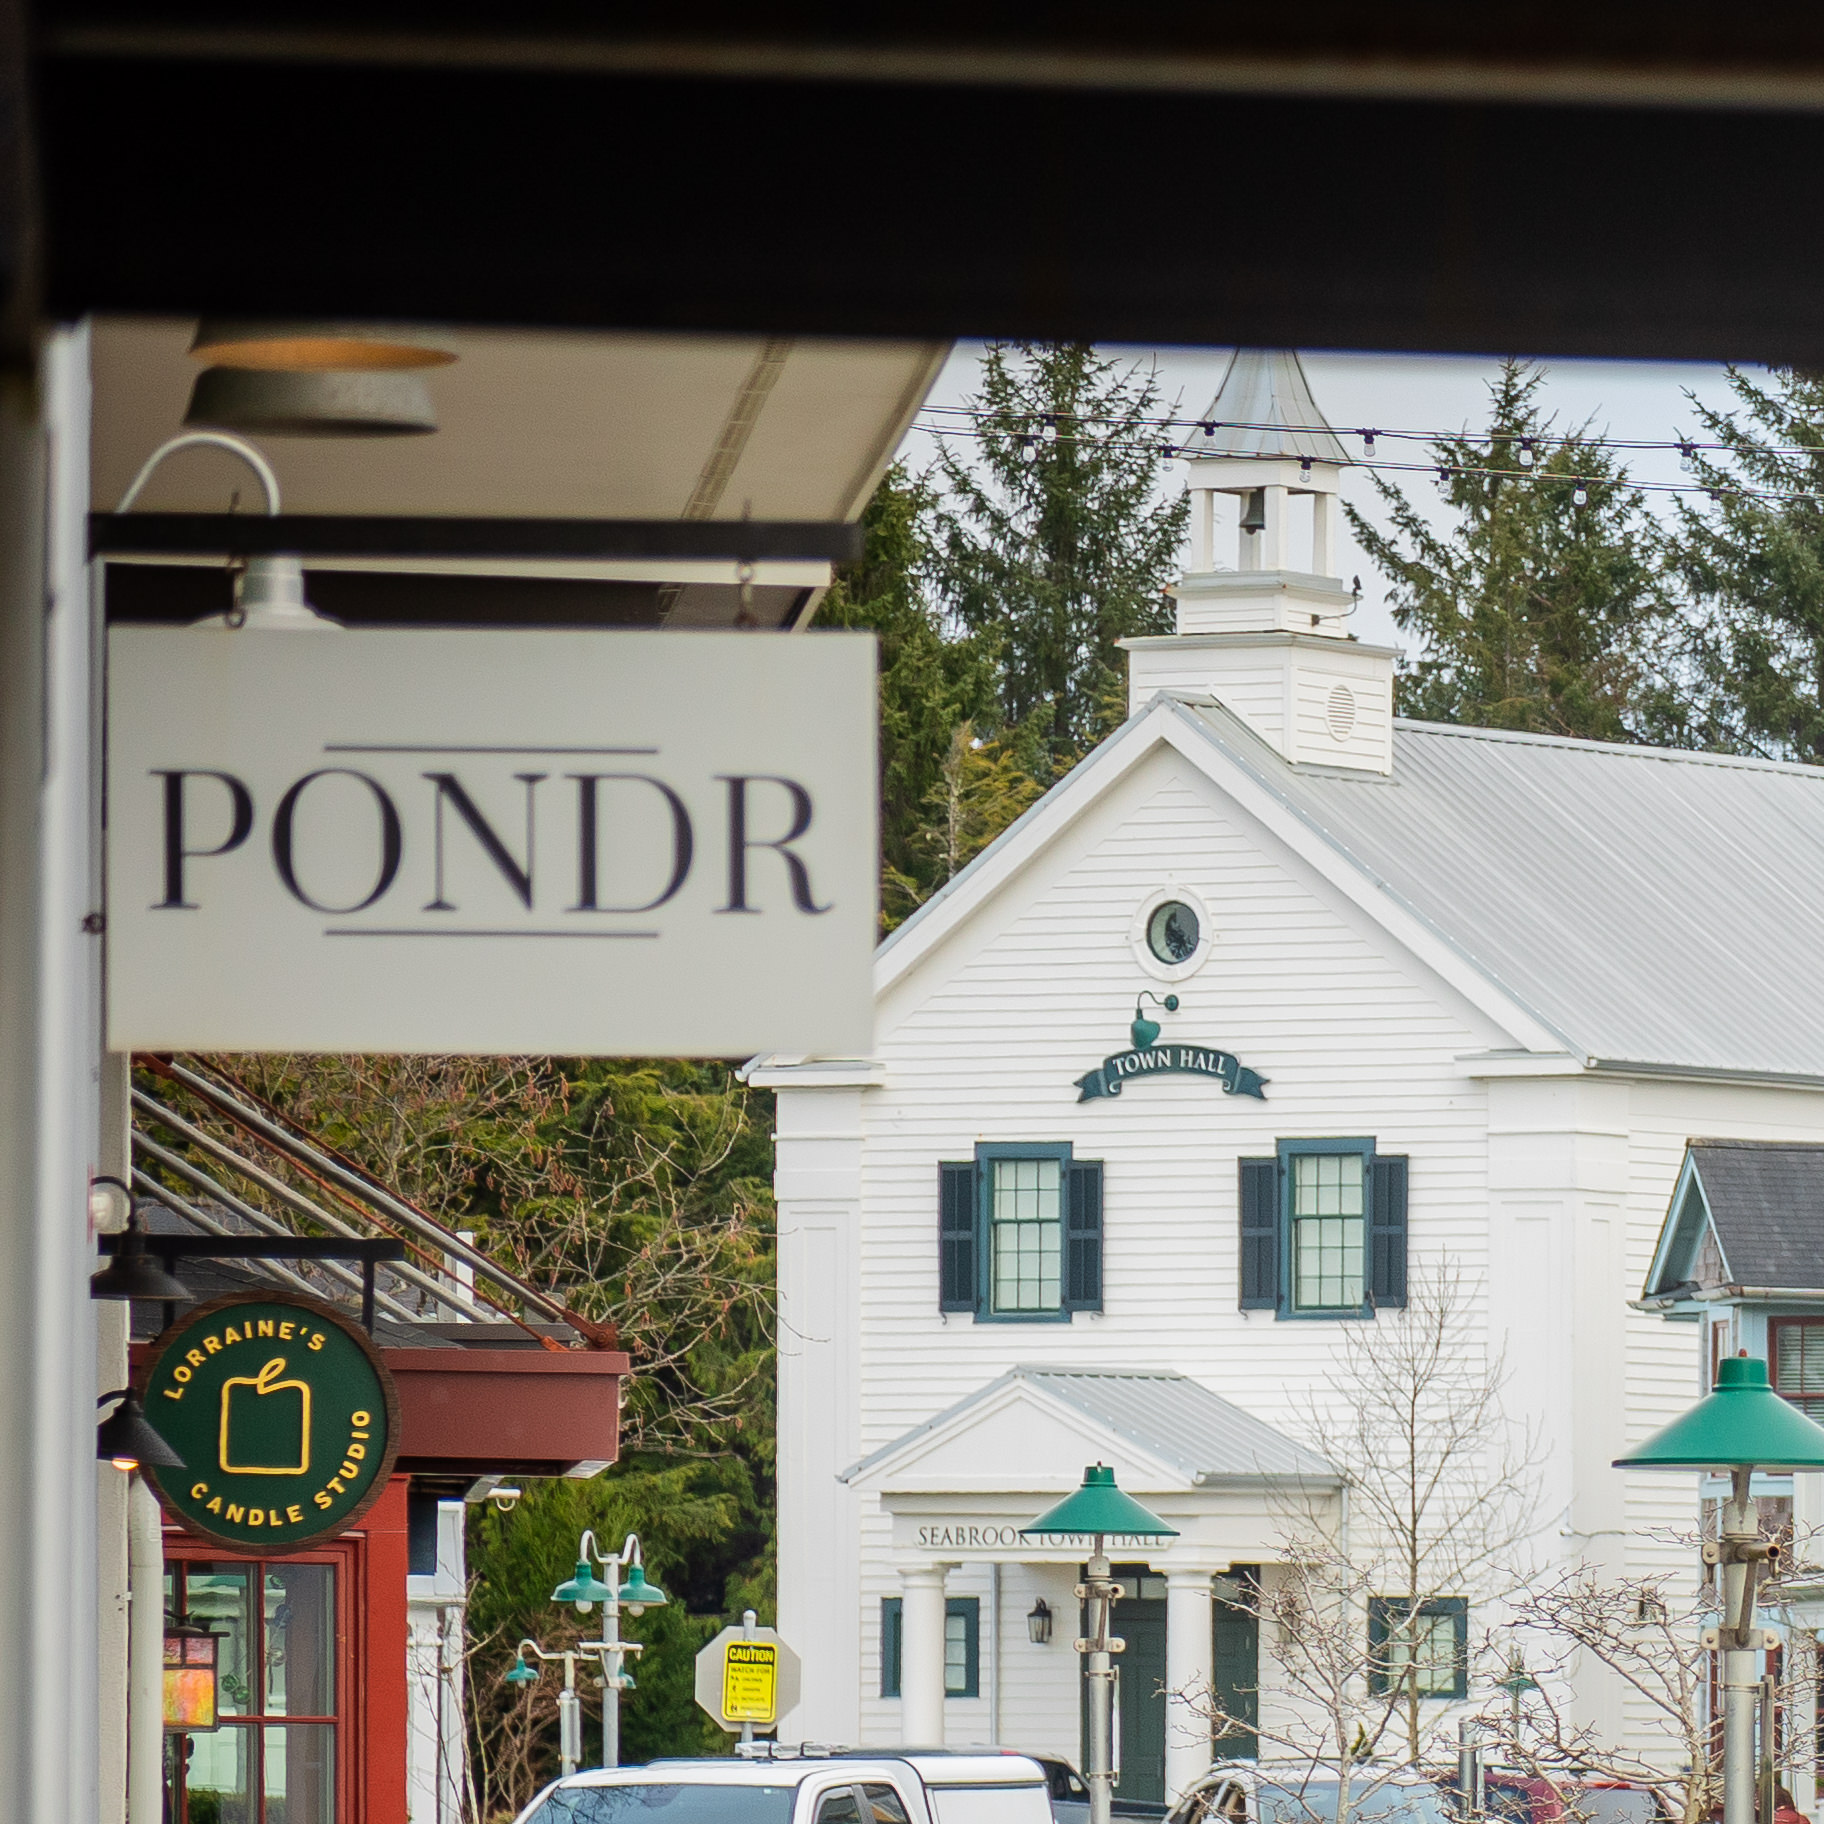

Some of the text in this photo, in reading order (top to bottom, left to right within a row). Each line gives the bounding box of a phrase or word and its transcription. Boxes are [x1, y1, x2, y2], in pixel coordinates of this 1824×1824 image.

[148, 767, 834, 916] PONDR
[1112, 1048, 1226, 1076] TOWN HALL
[163, 1319, 327, 1401] LORRAINE'S
[190, 1409, 371, 1527] CANDLE STUDIO
[918, 1526, 1031, 1546] SEABROOK
[728, 1647, 775, 1663] CAUTION
